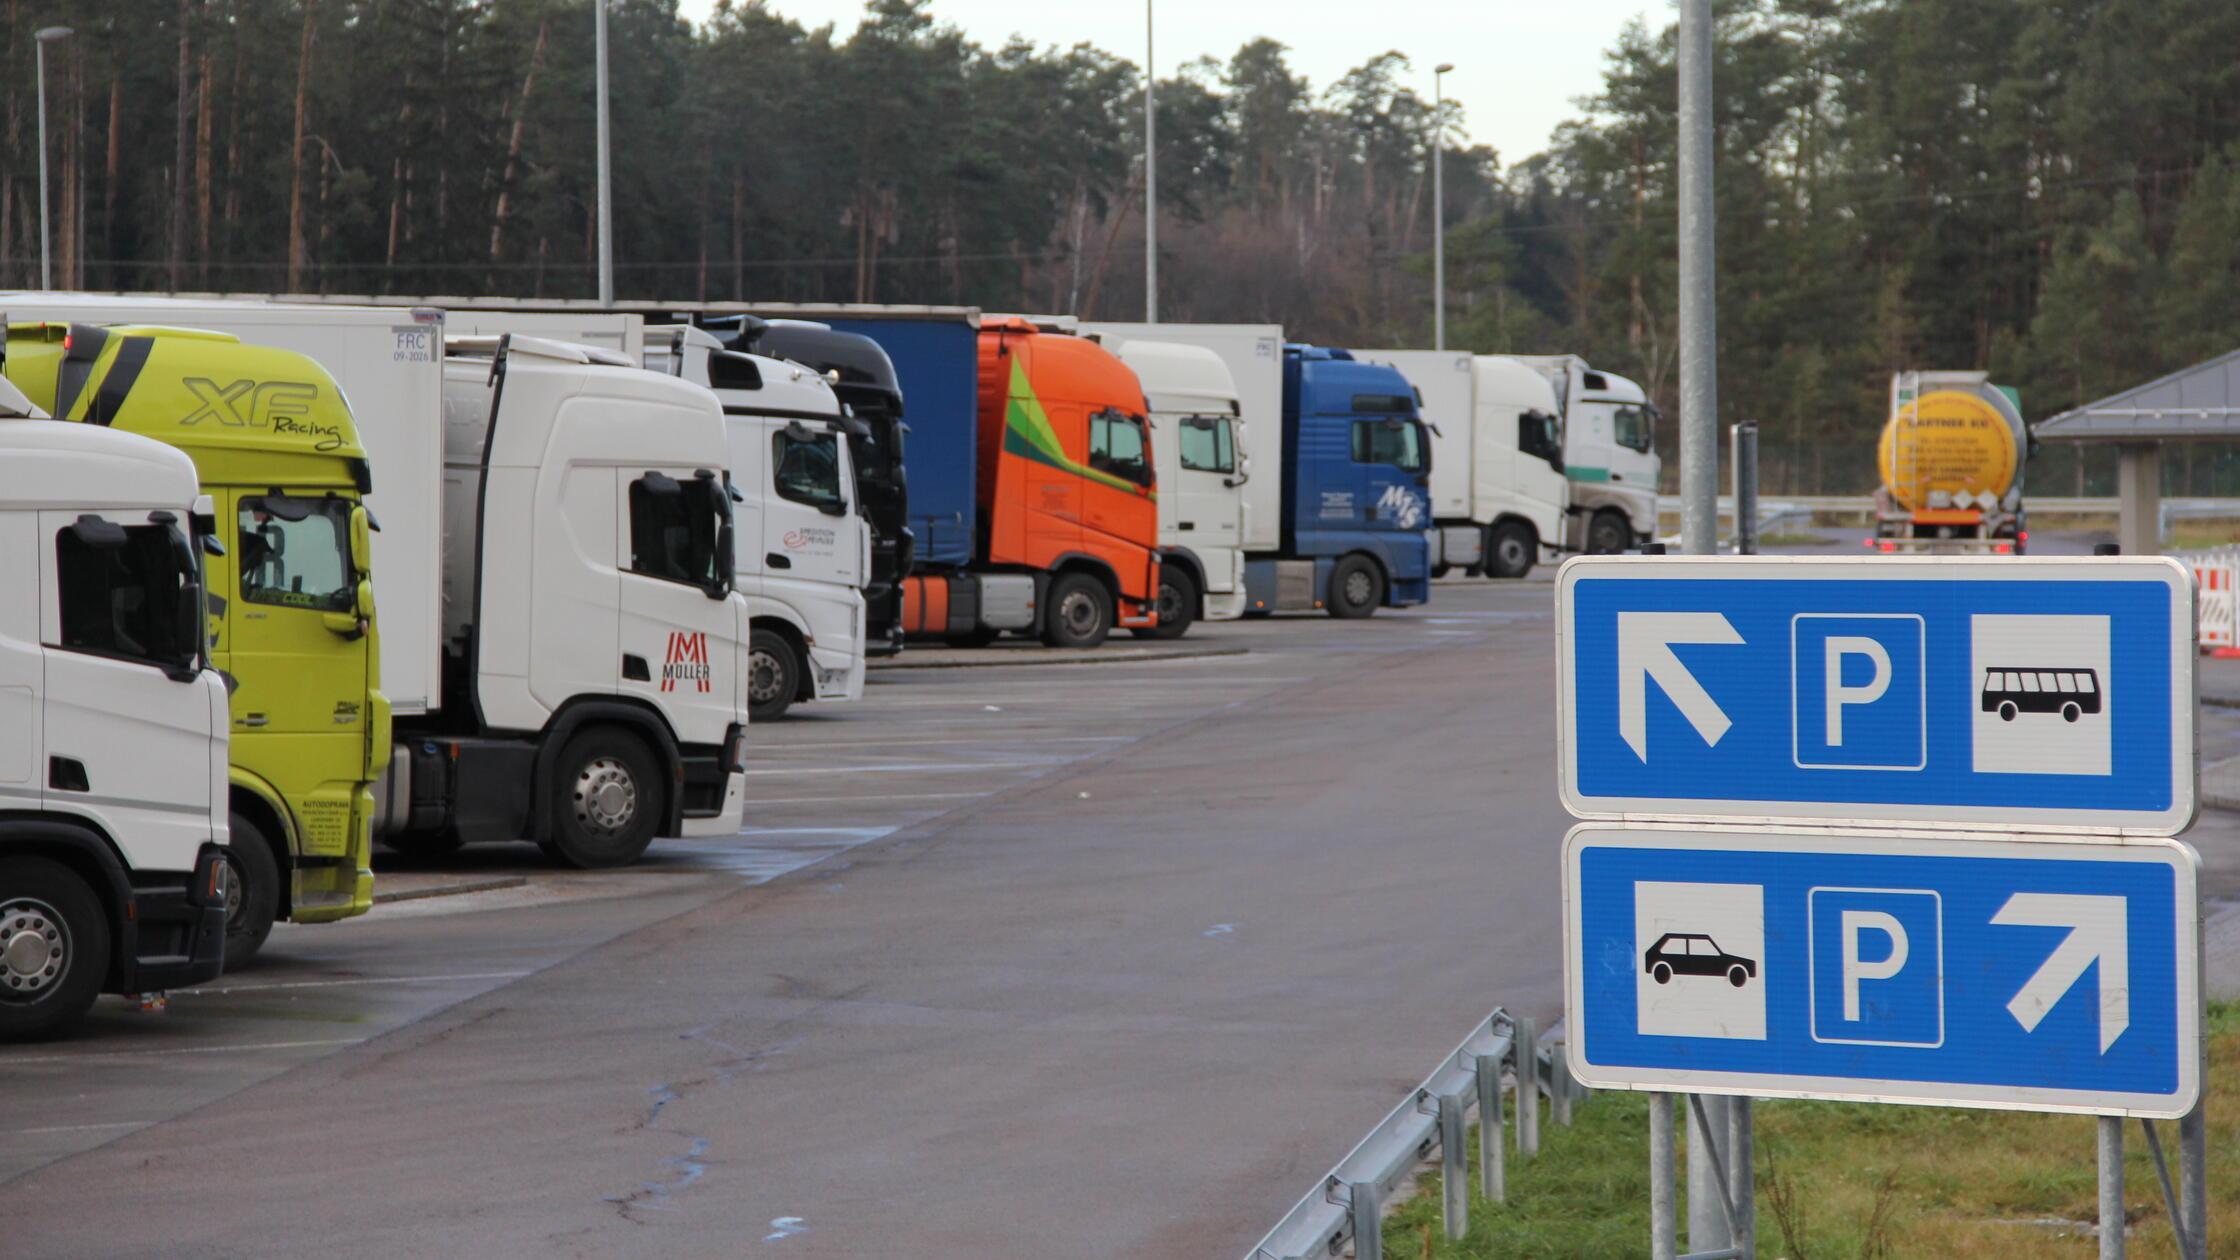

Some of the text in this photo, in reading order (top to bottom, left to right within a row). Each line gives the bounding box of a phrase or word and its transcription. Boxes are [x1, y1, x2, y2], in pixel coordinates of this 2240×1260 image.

[397, 333, 425, 350] FRC
[180, 377, 319, 427] XF
[272, 416, 350, 451] Racing
[1825, 636, 1893, 747] P
[1842, 910, 1910, 1021] P
